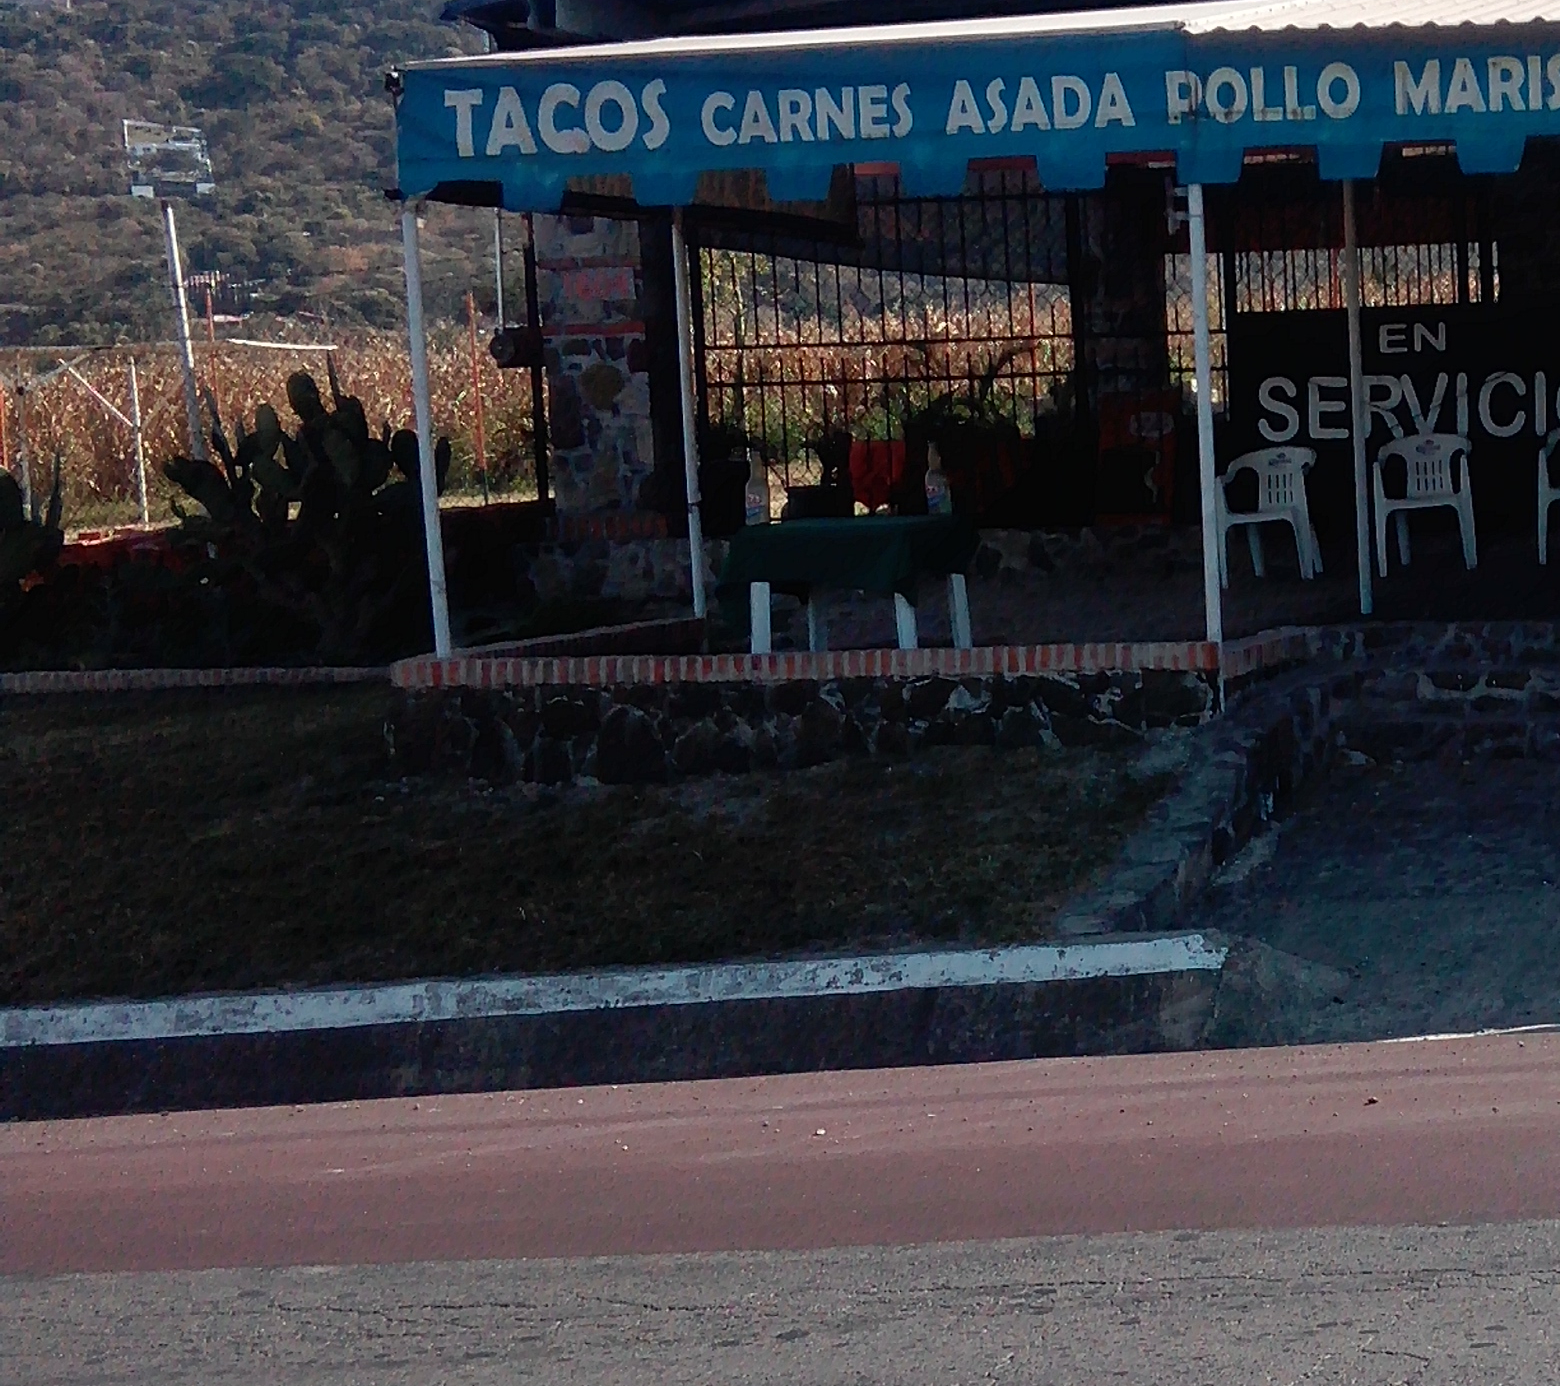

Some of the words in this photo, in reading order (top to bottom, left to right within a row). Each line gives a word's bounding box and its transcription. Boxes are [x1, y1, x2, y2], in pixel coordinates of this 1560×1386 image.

[444, 79, 671, 157] TACOS
[702, 83, 913, 146] CARNES
[945, 72, 1135, 135] ASADA
[1166, 61, 1361, 124] POLLO
[1379, 322, 1447, 353] EN
